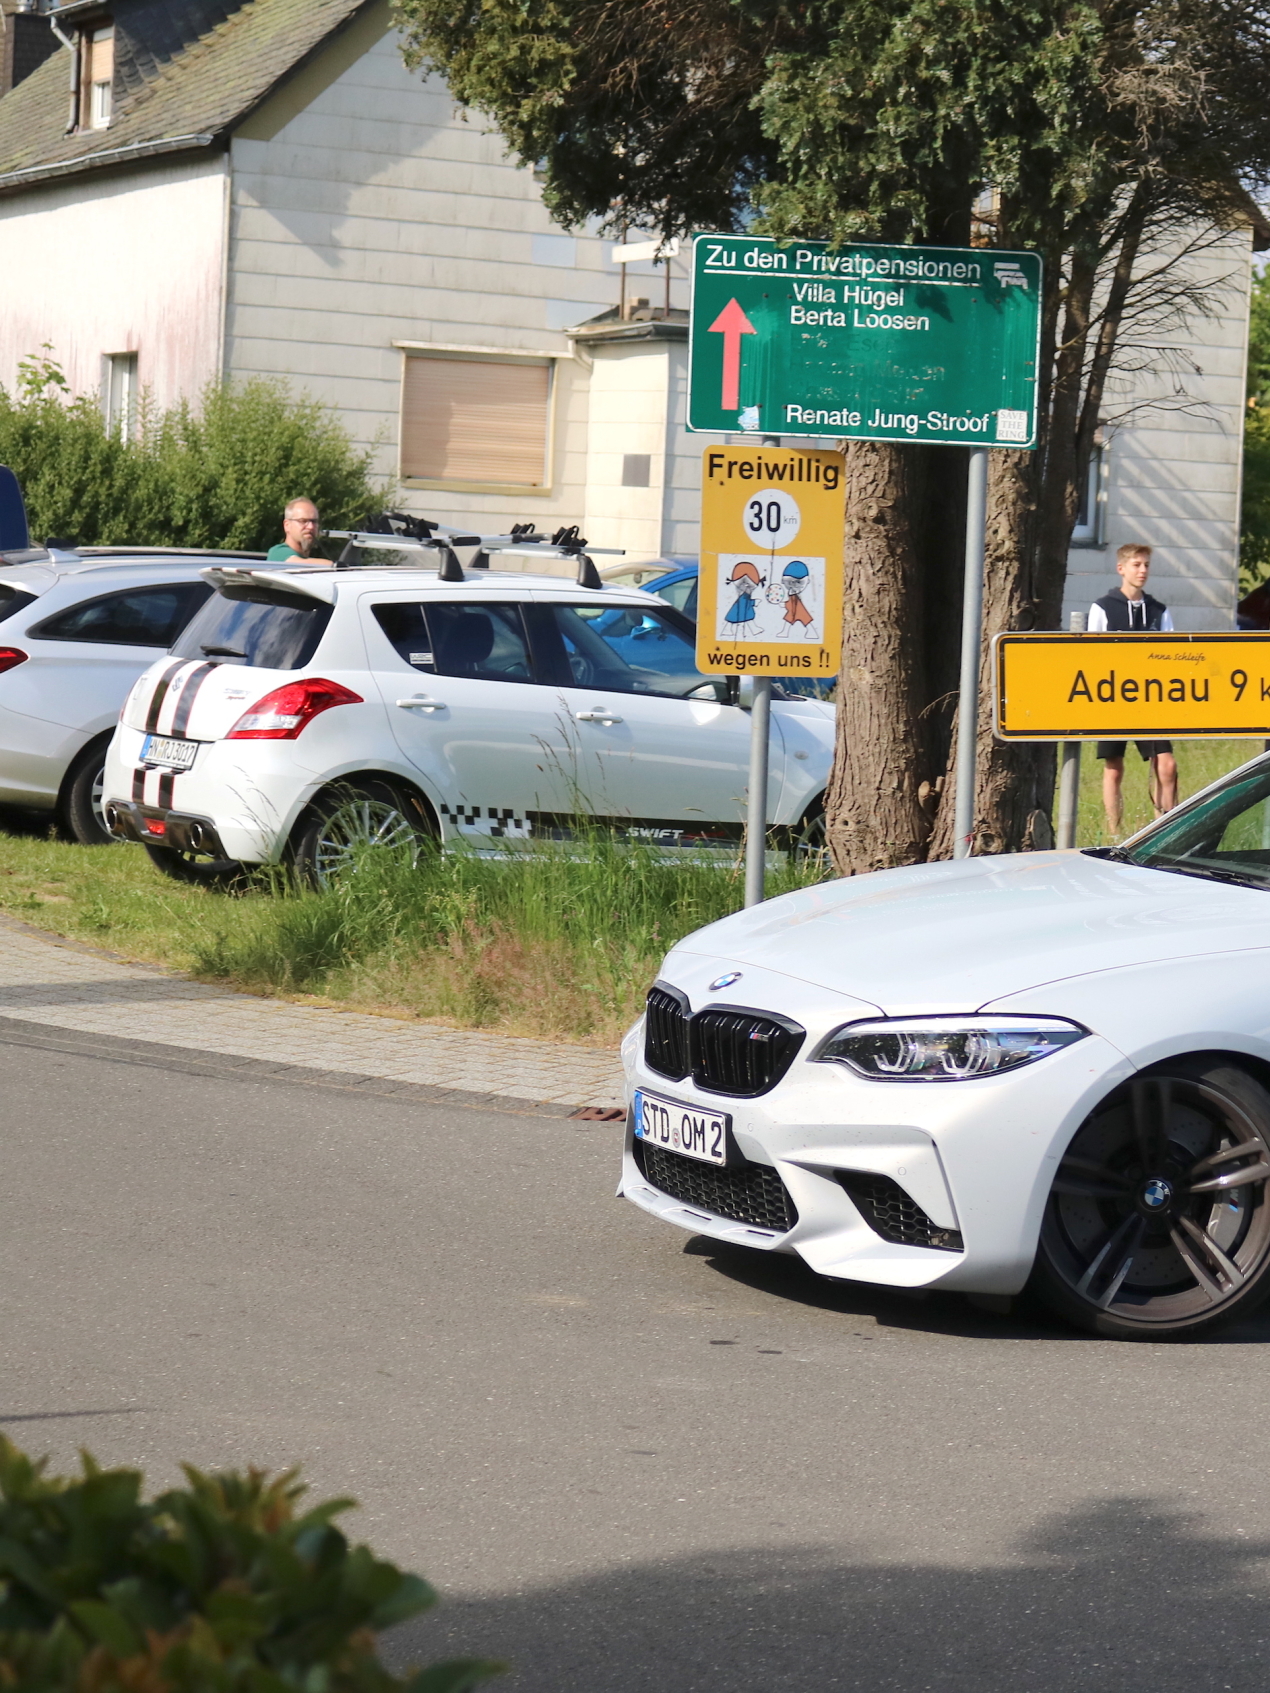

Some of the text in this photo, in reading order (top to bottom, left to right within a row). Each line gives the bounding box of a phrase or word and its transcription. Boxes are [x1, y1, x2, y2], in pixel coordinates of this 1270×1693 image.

[705, 245, 982, 280] Zu den Privatpensionen
[792, 283, 905, 310] Villa Hügel
[790, 305, 930, 331] Berta Loosen
[786, 404, 990, 434] Renate Jung-Stroof
[1000, 411, 1025, 420] SAVE
[1001, 420, 1023, 429] THE
[998, 430, 1025, 439] RING
[708, 453, 839, 490] Freiwillig
[749, 500, 798, 532] 30 km
[708, 653, 770, 670] wegen
[778, 654, 812, 668] uns
[1067, 669, 1209, 703] Adenau
[1229, 668, 1248, 702] 9
[642, 1100, 670, 1143] STD
[681, 1114, 706, 1153] OM
[711, 1120, 723, 1158] 2
